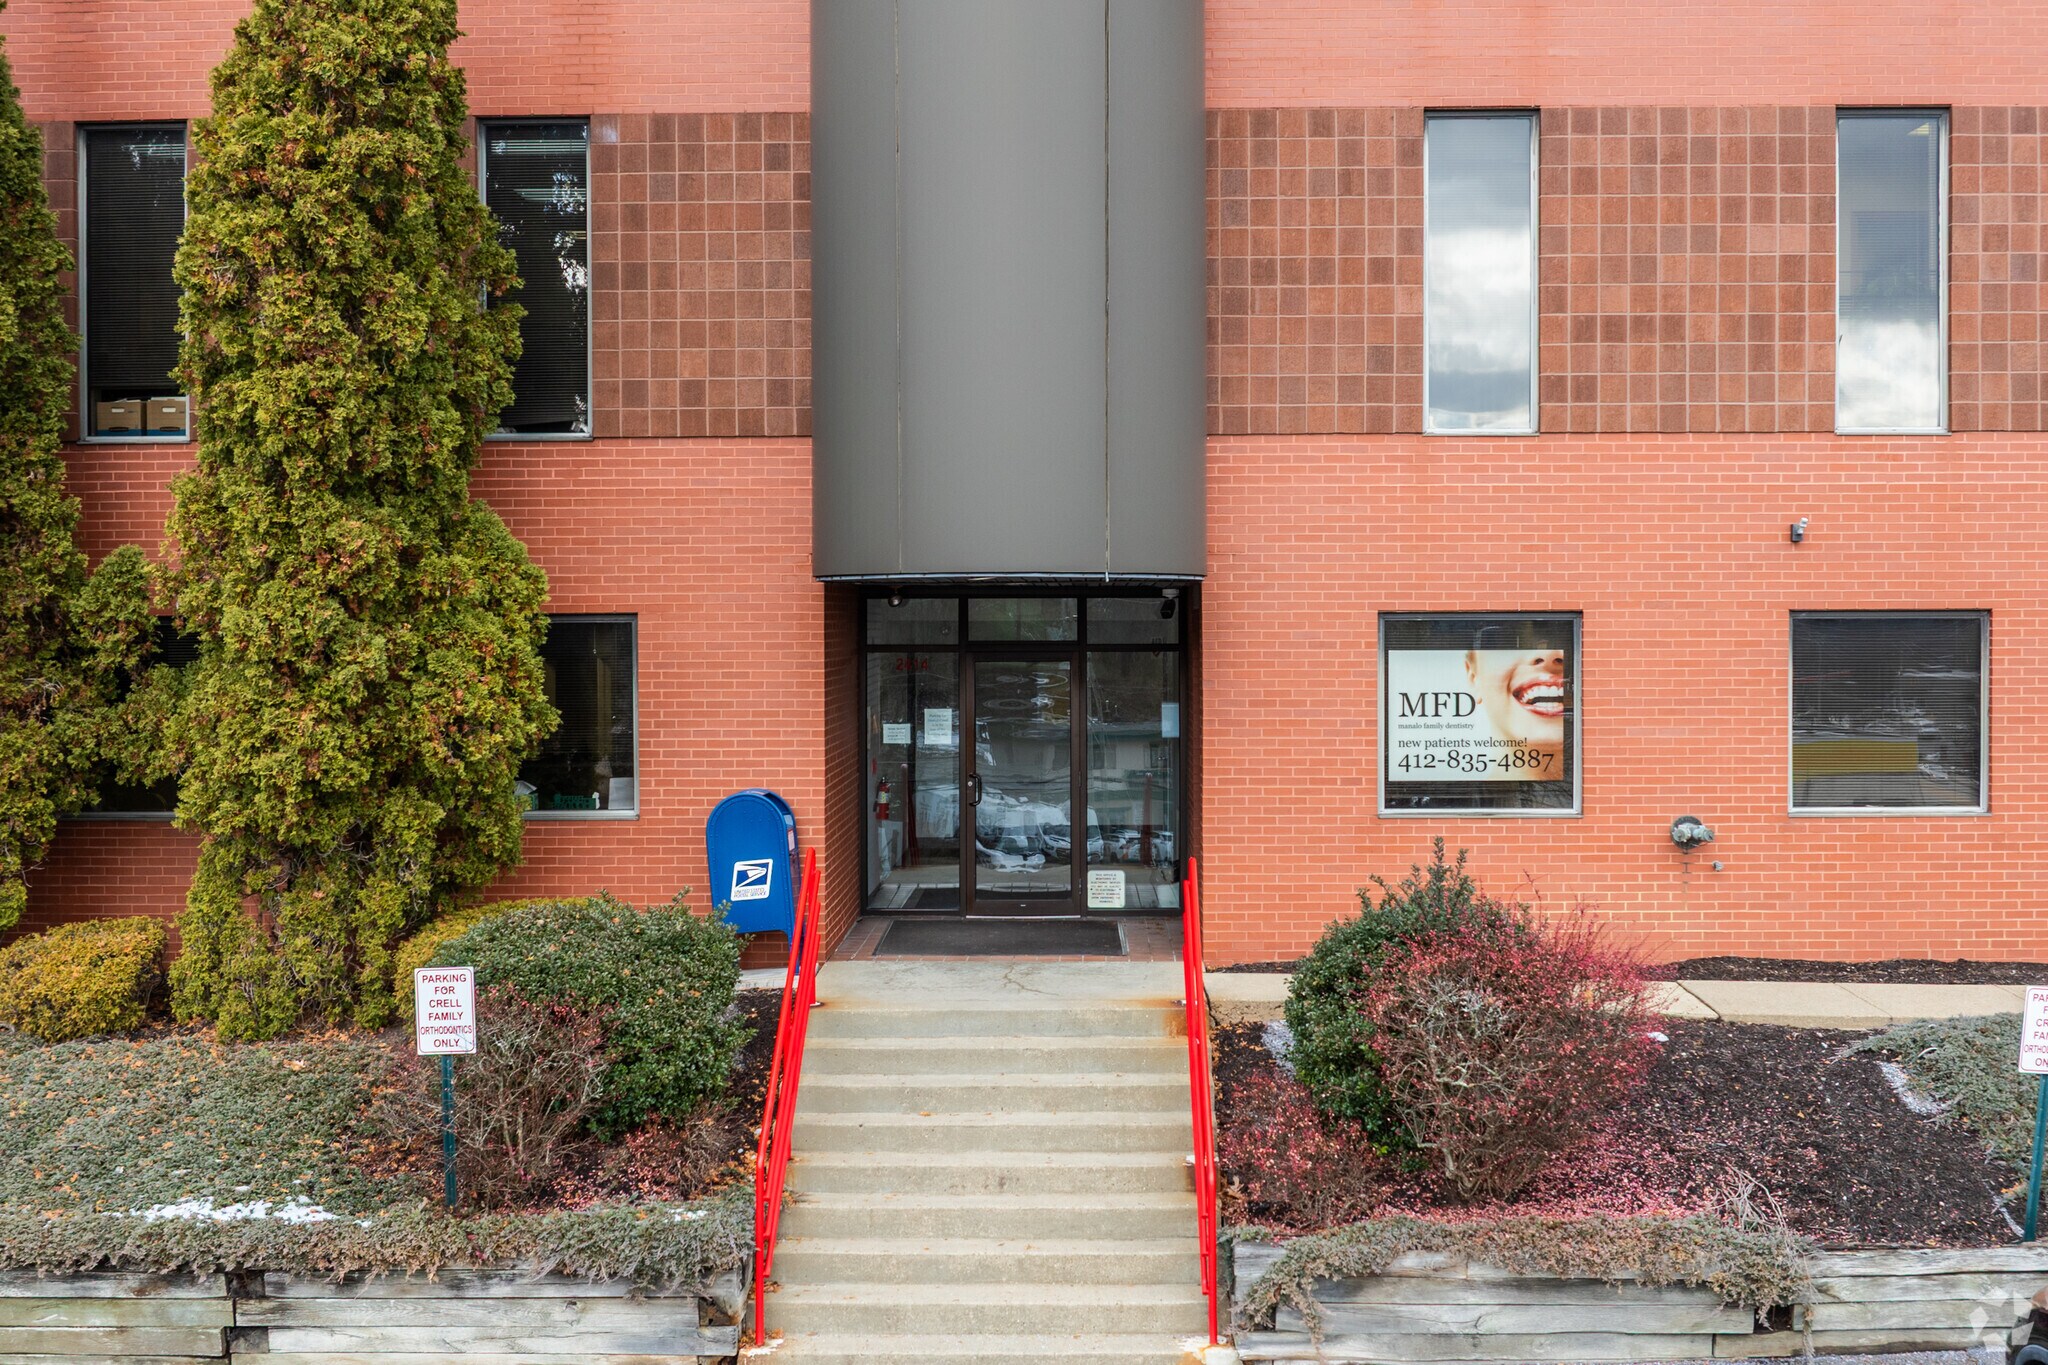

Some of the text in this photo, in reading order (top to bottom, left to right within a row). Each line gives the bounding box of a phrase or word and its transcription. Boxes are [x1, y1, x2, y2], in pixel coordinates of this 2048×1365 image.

[1398, 692, 1476, 717] MFD
[1423, 722, 1444, 730] family
[1445, 722, 1474, 730] dentistry
[1398, 737, 1527, 750] new patients welcome!
[1398, 749, 1555, 773] 412-835-4887
[422, 974, 467, 983] PARKING
[434, 986, 455, 995] FOR
[429, 999, 462, 1008] CRELL
[428, 1012, 464, 1021] FAMILY
[420, 1025, 473, 1035] ORTHODONTICS
[433, 1039, 460, 1047] ONLY
